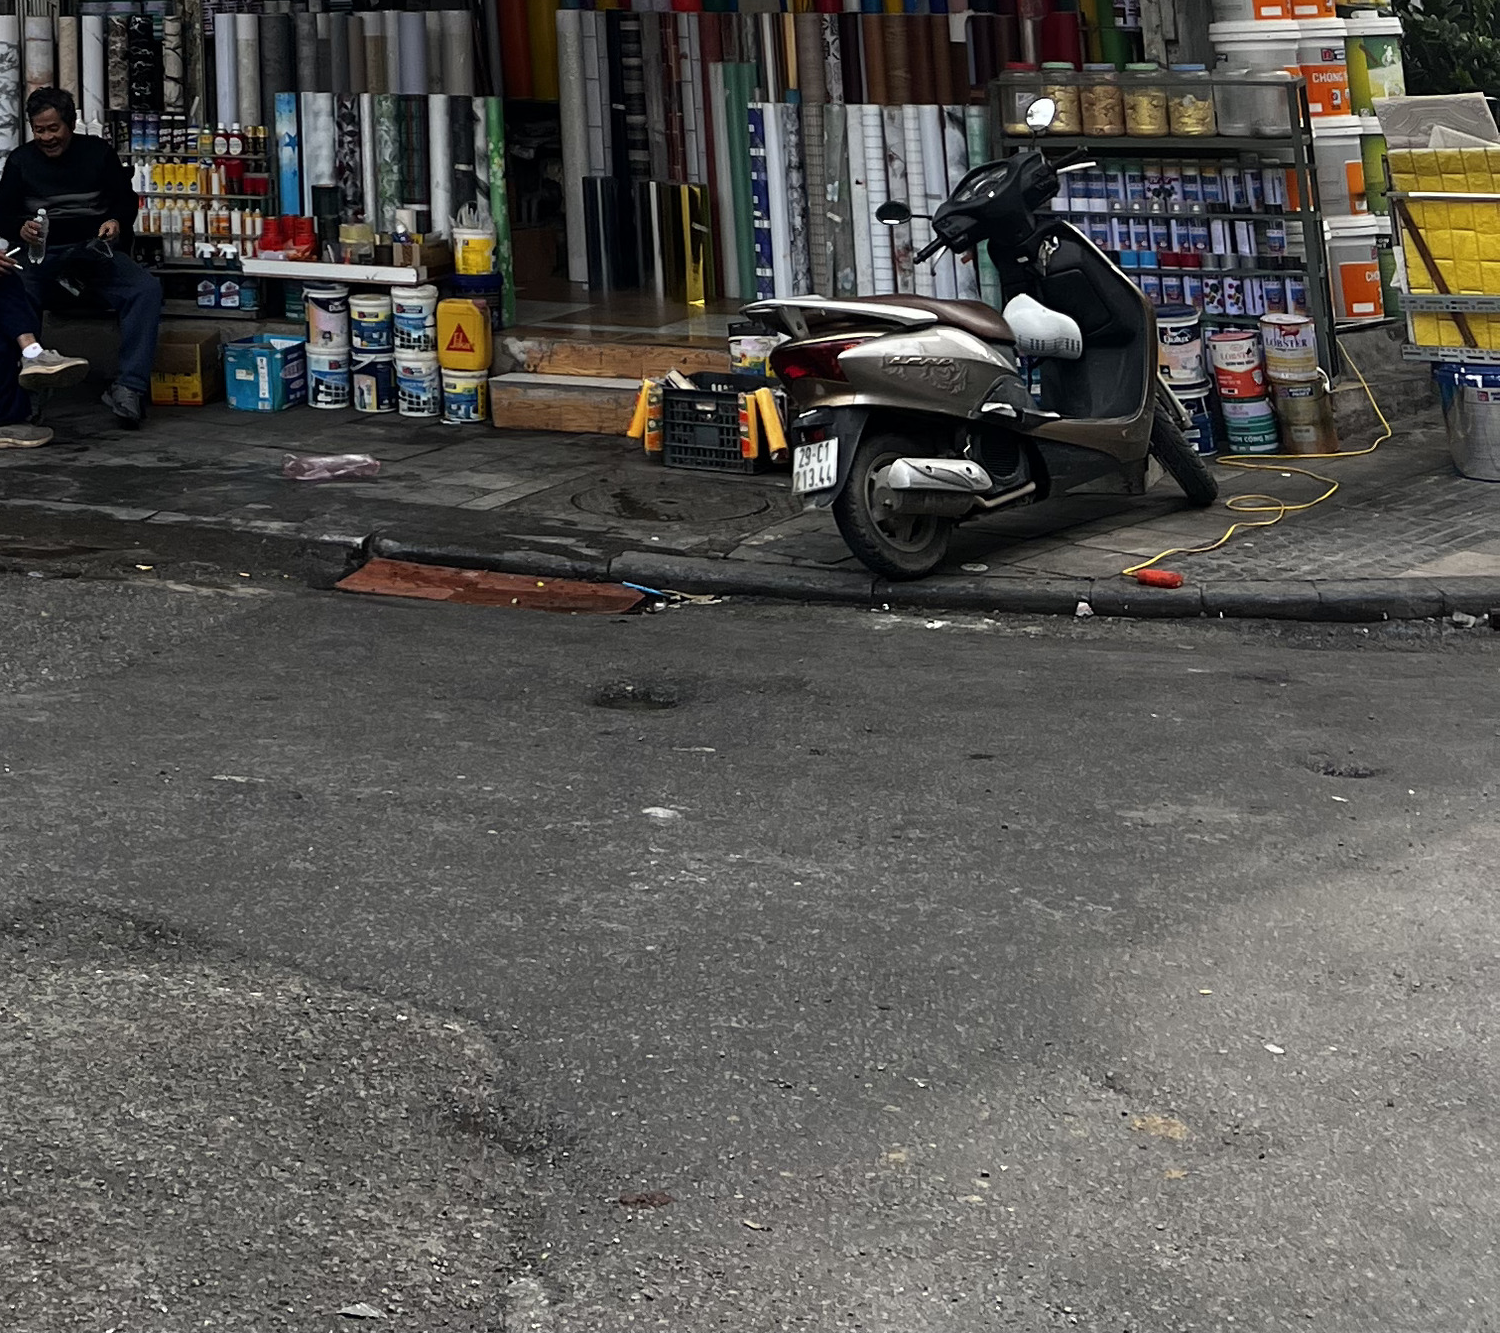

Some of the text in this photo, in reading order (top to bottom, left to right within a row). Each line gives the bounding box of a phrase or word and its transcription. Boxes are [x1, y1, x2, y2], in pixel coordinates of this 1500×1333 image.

[1266, 336, 1308, 349] LOBSTER
[797, 440, 830, 470] 29-C1
[794, 463, 833, 493] 213.44
